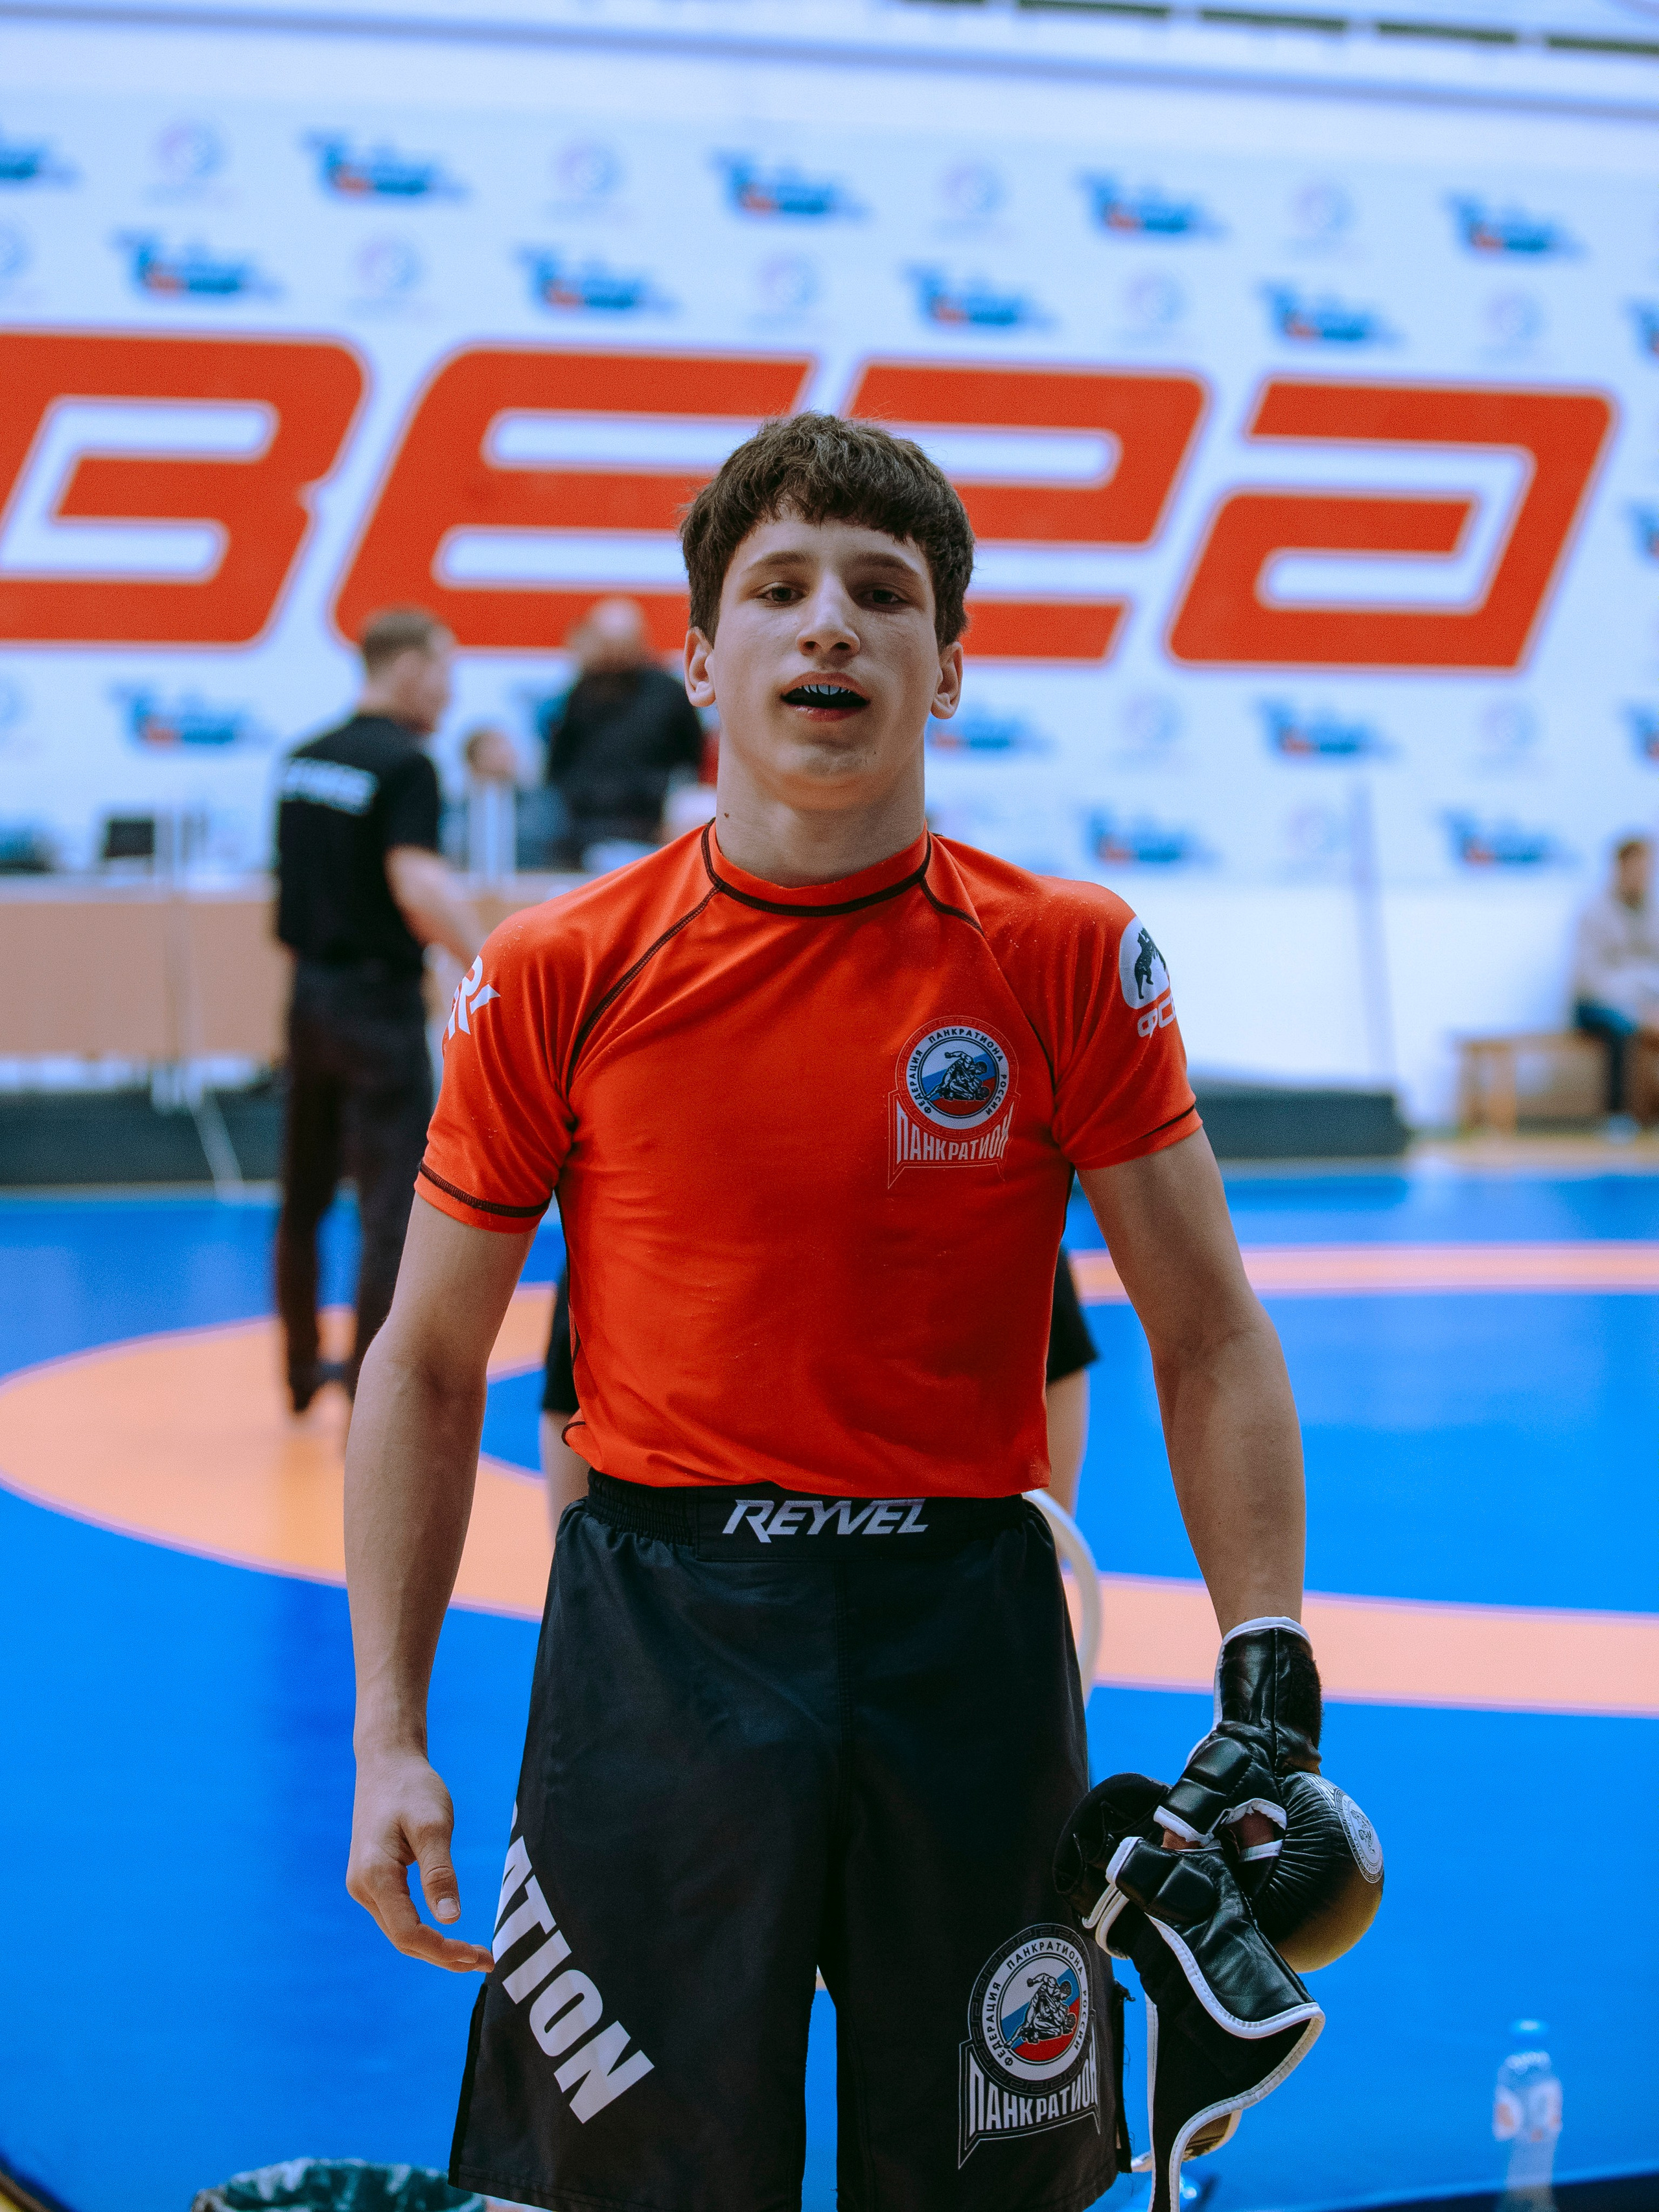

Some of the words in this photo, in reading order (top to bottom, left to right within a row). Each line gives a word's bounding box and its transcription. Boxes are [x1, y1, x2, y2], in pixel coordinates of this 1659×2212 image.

[909, 1049, 932, 1114] ФЕДЕРАЦИЯ
[928, 1028, 1003, 1062] ПАНКРАТИОНА
[986, 1074, 1008, 1115] РОССИИ
[896, 1100, 1015, 1165] ПАНКРАТИОН
[722, 1498, 929, 1543] REYVEL
[988, 1982, 1014, 2067] ФЕДЕРАЦИЯ
[1006, 1941, 1083, 1976] ПАНКРАТИОНА
[1073, 1990, 1087, 2051] РОССИИ
[969, 2022, 1098, 2137] ПАНКРАТИОН
